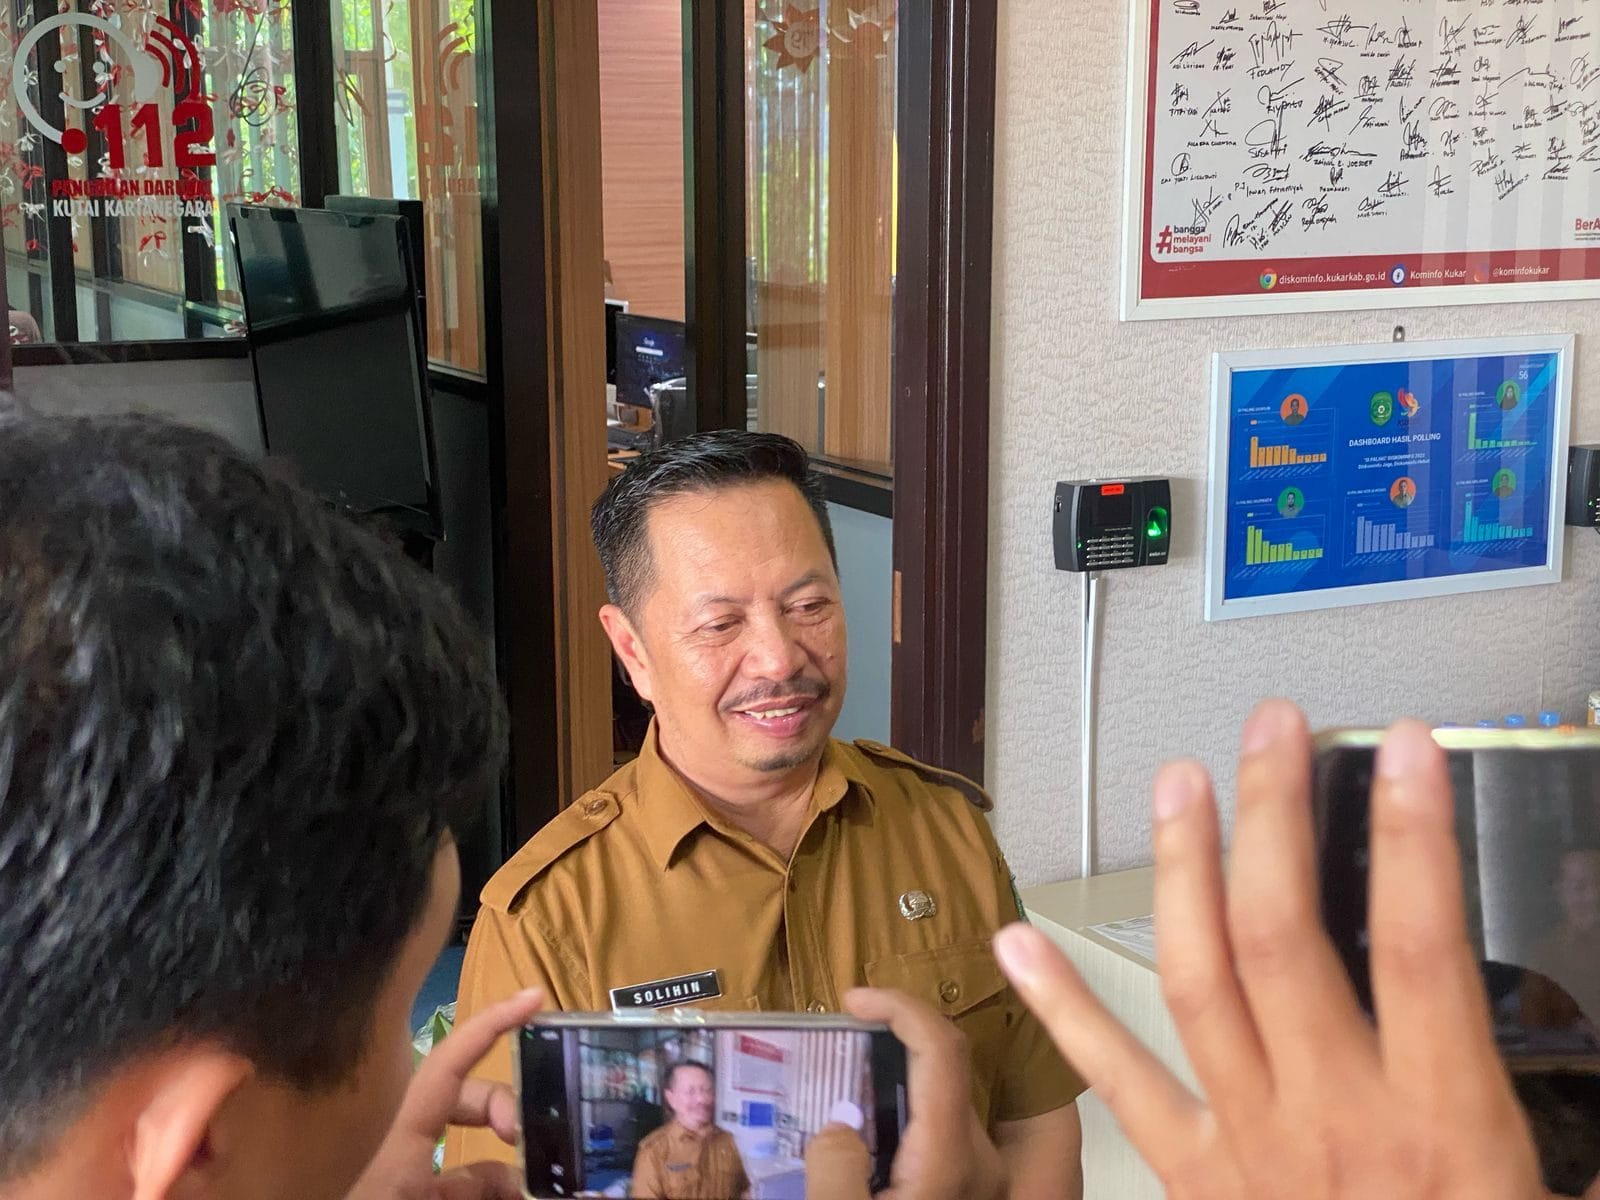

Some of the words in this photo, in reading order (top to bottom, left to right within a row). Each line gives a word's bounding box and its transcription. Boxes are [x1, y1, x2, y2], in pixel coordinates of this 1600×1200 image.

[94, 104, 216, 168] 112
[53, 200, 100, 217] KUTAI
[104, 200, 214, 217] KARTANEGARA
[1173, 224, 1206, 235] bangga
[1173, 234, 1212, 245] melayani
[1173, 244, 1204, 255] bangsa
[1410, 269, 1443, 280] Kominfo
[1444, 269, 1467, 279] Kukar
[1492, 266, 1550, 277] @kominfokukar
[1279, 271, 1386, 284] diskominfo.kukarkab.go.id
[1519, 370, 1528, 380] 56
[1349, 437, 1391, 447] DASHBOARD
[1392, 435, 1411, 443] HASIL
[1412, 433, 1441, 442] POLLING
[634, 981, 700, 1004] SOLIHIN
